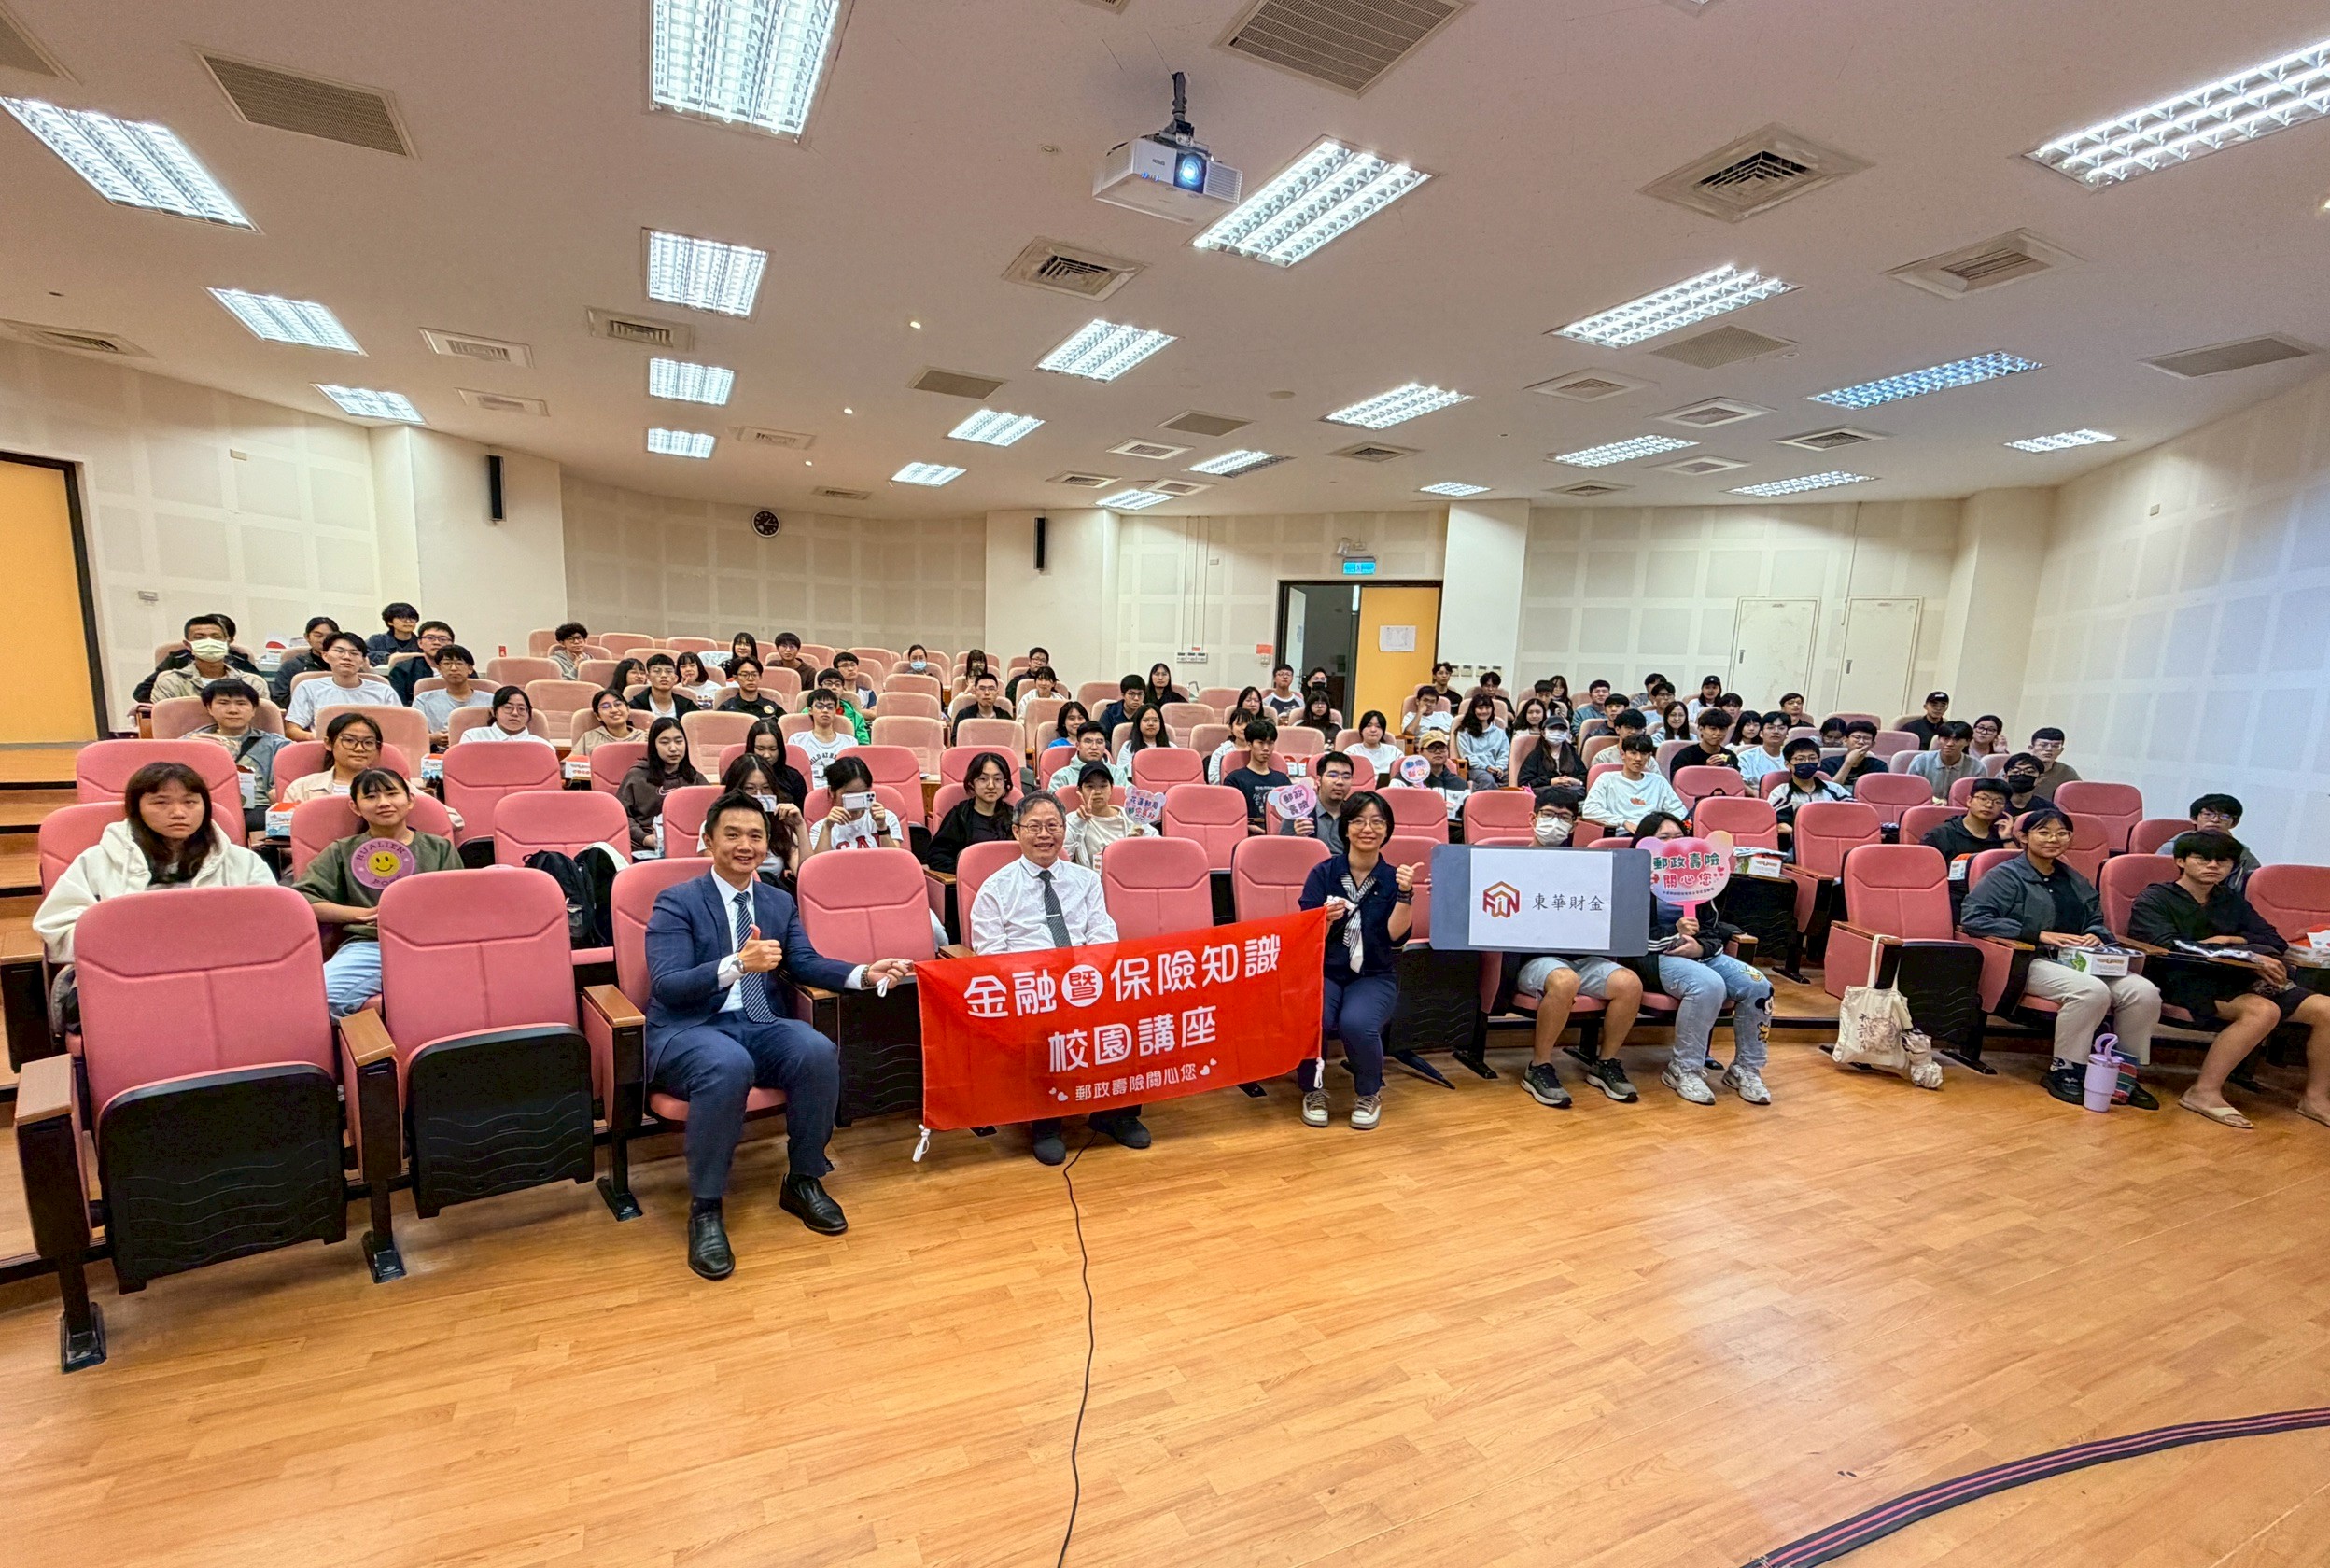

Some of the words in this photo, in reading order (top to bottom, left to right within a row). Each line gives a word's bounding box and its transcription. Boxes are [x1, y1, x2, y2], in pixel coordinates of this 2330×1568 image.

[1283, 789, 1304, 804] 郵政
[356, 842, 405, 861] HUALIEN
[1652, 852, 1720, 870] 郵政壽險
[1663, 872, 1712, 889] 關心您
[1532, 892, 1605, 912] 東華財金
[962, 933, 1282, 1019] 金融暨保險知識
[1048, 1004, 1217, 1073] 校園講座
[1074, 1063, 1198, 1102] 郵政壽險關心您
